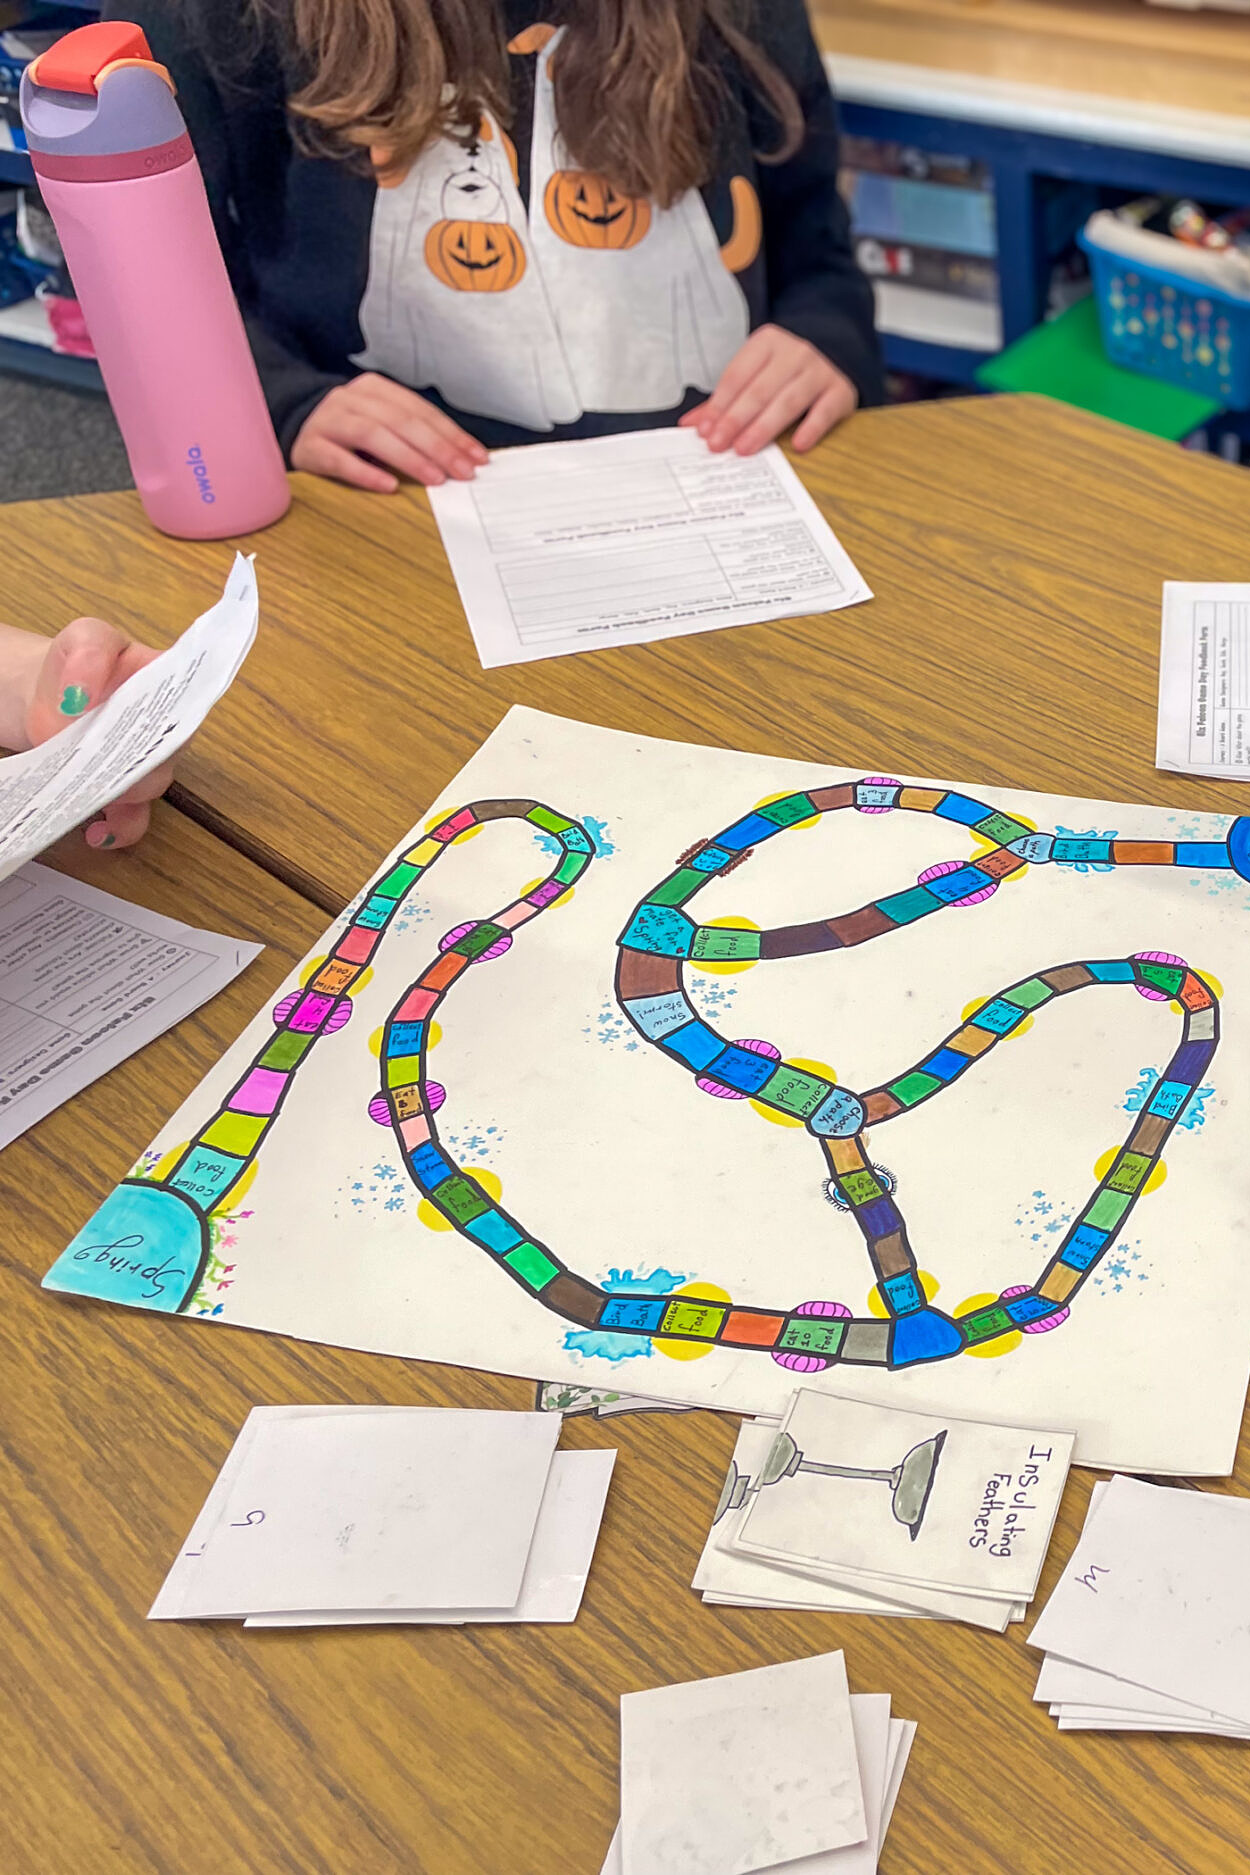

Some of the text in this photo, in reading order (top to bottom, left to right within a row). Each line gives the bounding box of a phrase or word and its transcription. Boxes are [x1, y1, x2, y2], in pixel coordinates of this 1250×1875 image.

[187, 446, 215, 504] owala
[73, 1234, 187, 1299] Spring
[608, 1303, 627, 1325] Bird
[678, 1309, 708, 1333] food
[815, 1326, 836, 1351] food
[969, 1472, 1013, 1548] Feathers
